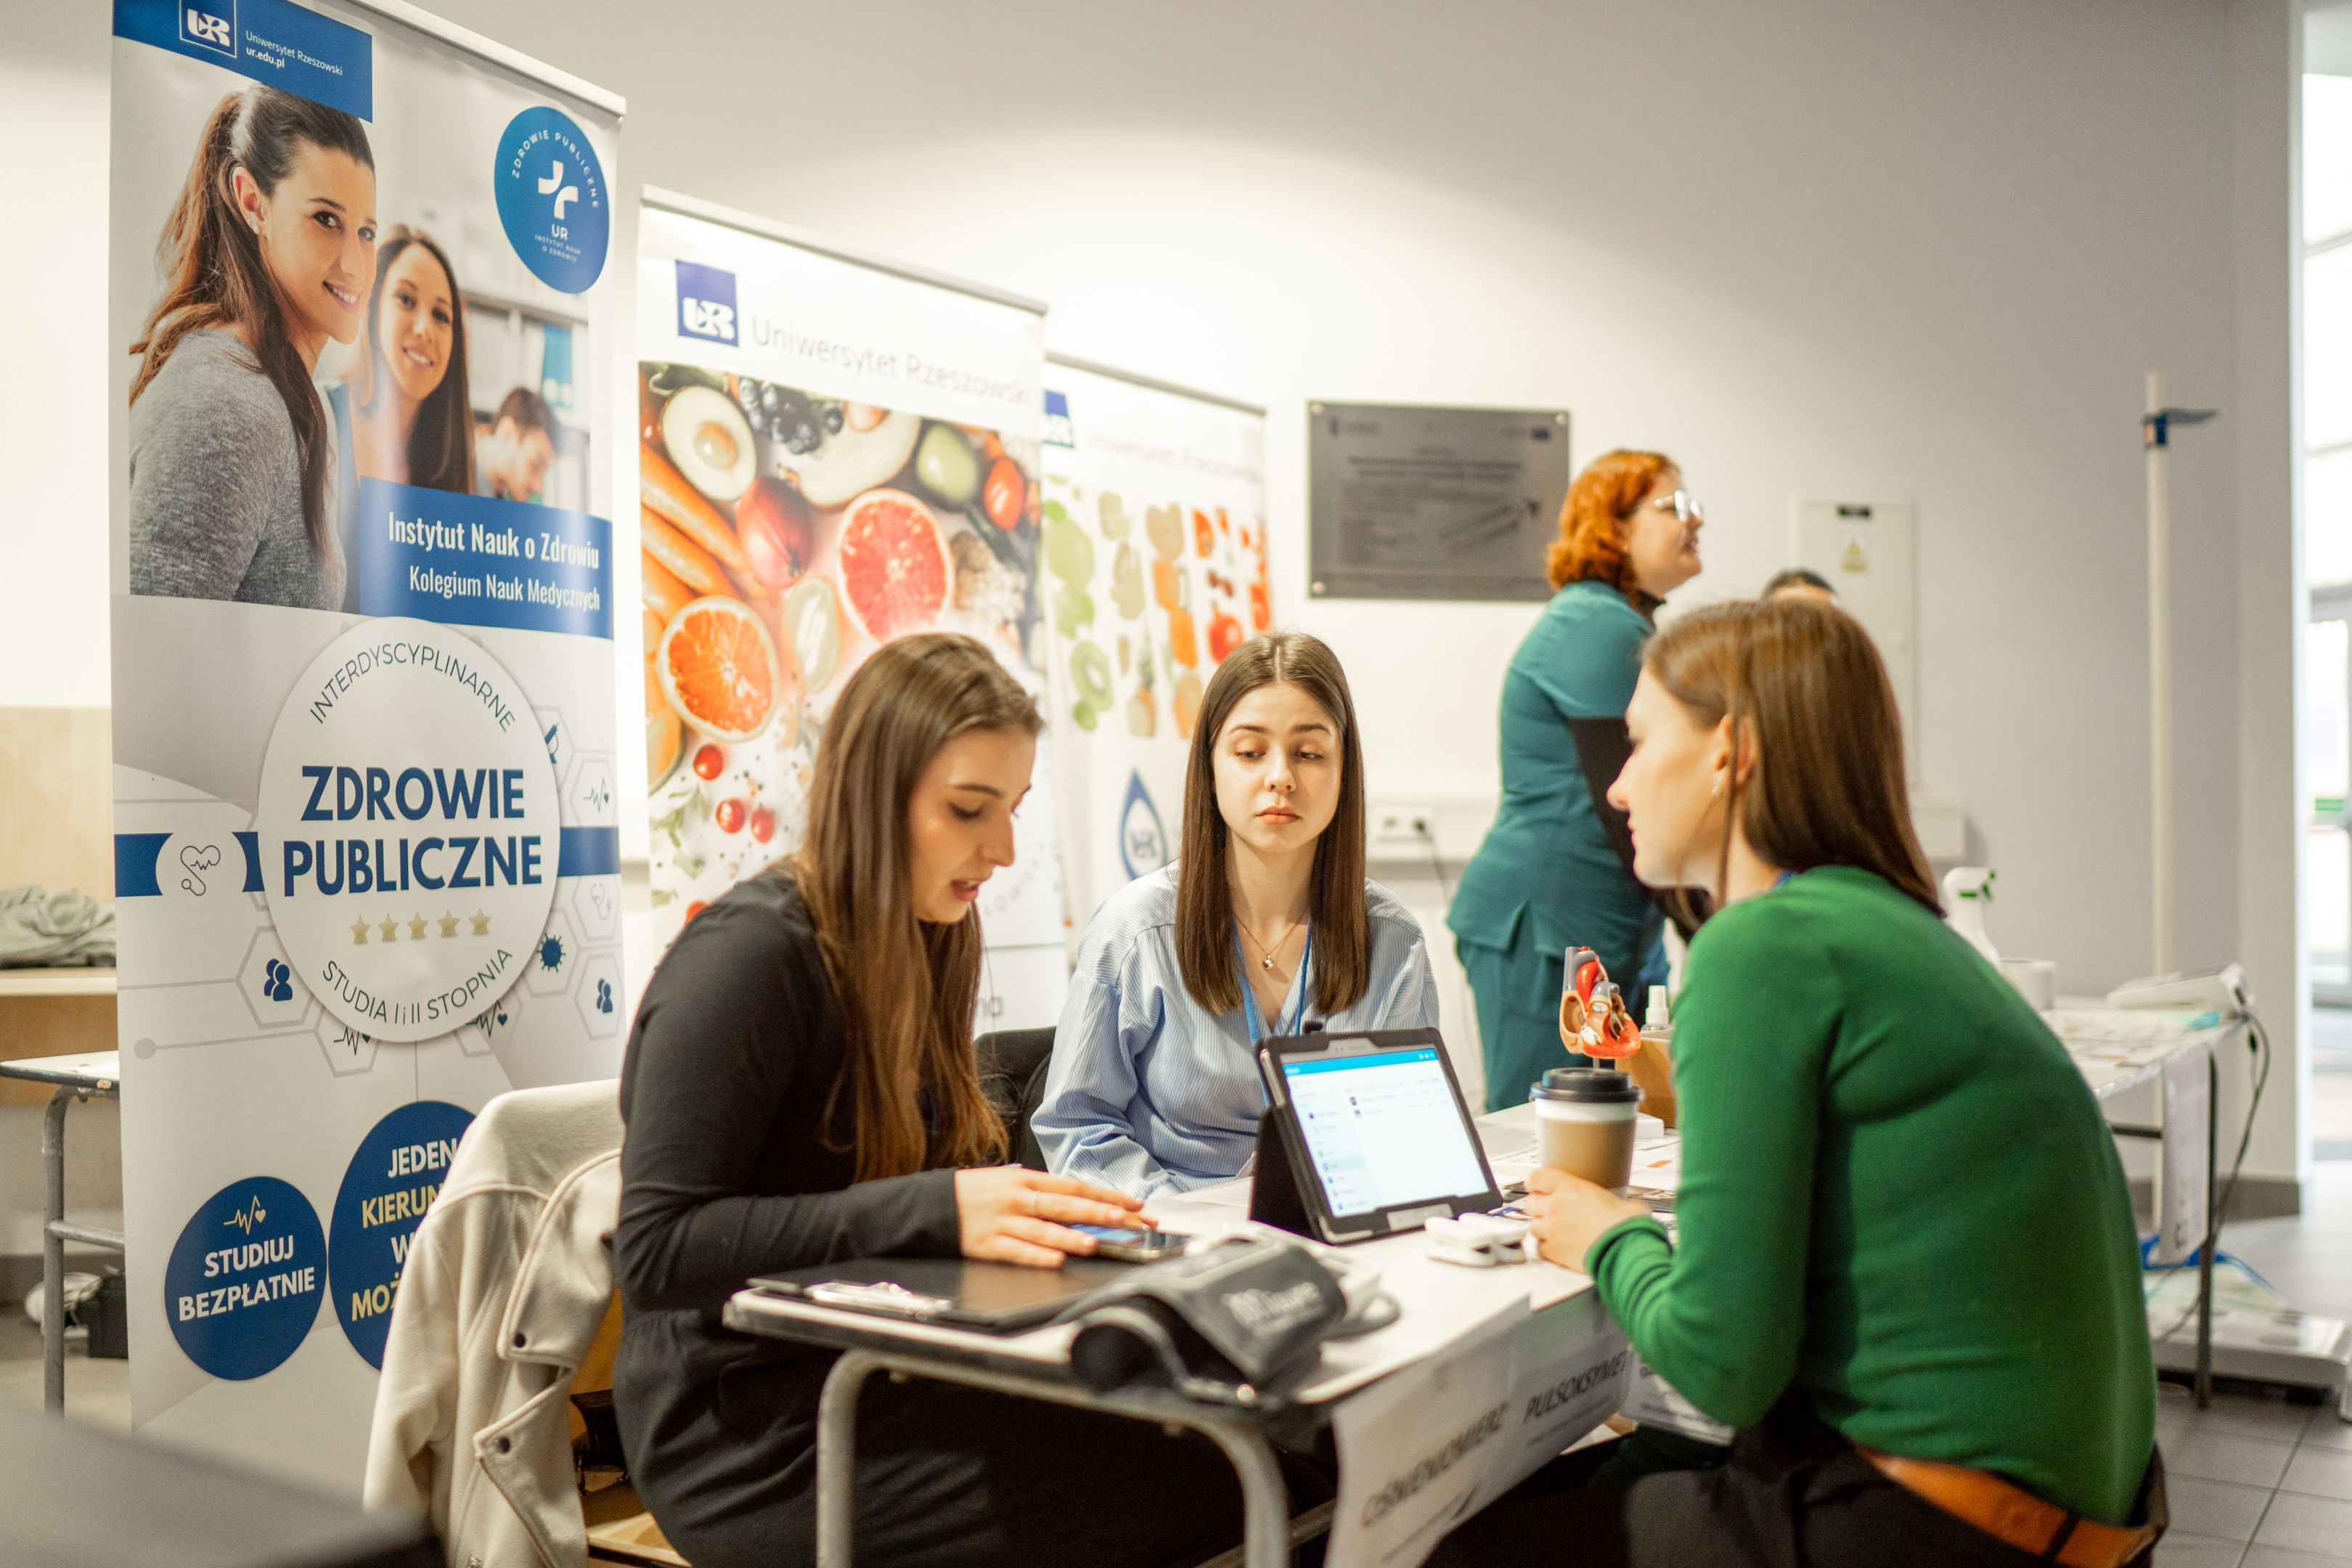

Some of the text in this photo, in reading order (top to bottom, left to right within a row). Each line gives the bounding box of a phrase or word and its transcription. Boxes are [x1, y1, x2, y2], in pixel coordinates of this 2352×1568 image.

[245, 30, 343, 75] Uniwersytet Rzeszowski
[246, 46, 285, 69] ur.edu.pl
[512, 129, 599, 208] ZDROWIE PUBLICZNE
[552, 224, 568, 241] UR
[752, 314, 1031, 407] Uniwersytet Rzeszowski
[388, 510, 599, 570] Instytut Nauk o Zdrowiu
[409, 565, 600, 612] Kolegium Nauk Medycznych
[309, 642, 516, 732] INTERDYSCYPLINARNE
[301, 765, 525, 822] ZDROWIE
[283, 835, 542, 897] PUBLICZNE
[322, 960, 387, 1023] STUDIA
[427, 948, 513, 1020] STOPNIA
[388, 1138, 457, 1179] JEDEN
[204, 1234, 294, 1278] STUDIUJ
[391, 1232, 416, 1264] W
[179, 1267, 315, 1322] BEZPŁATNIE
